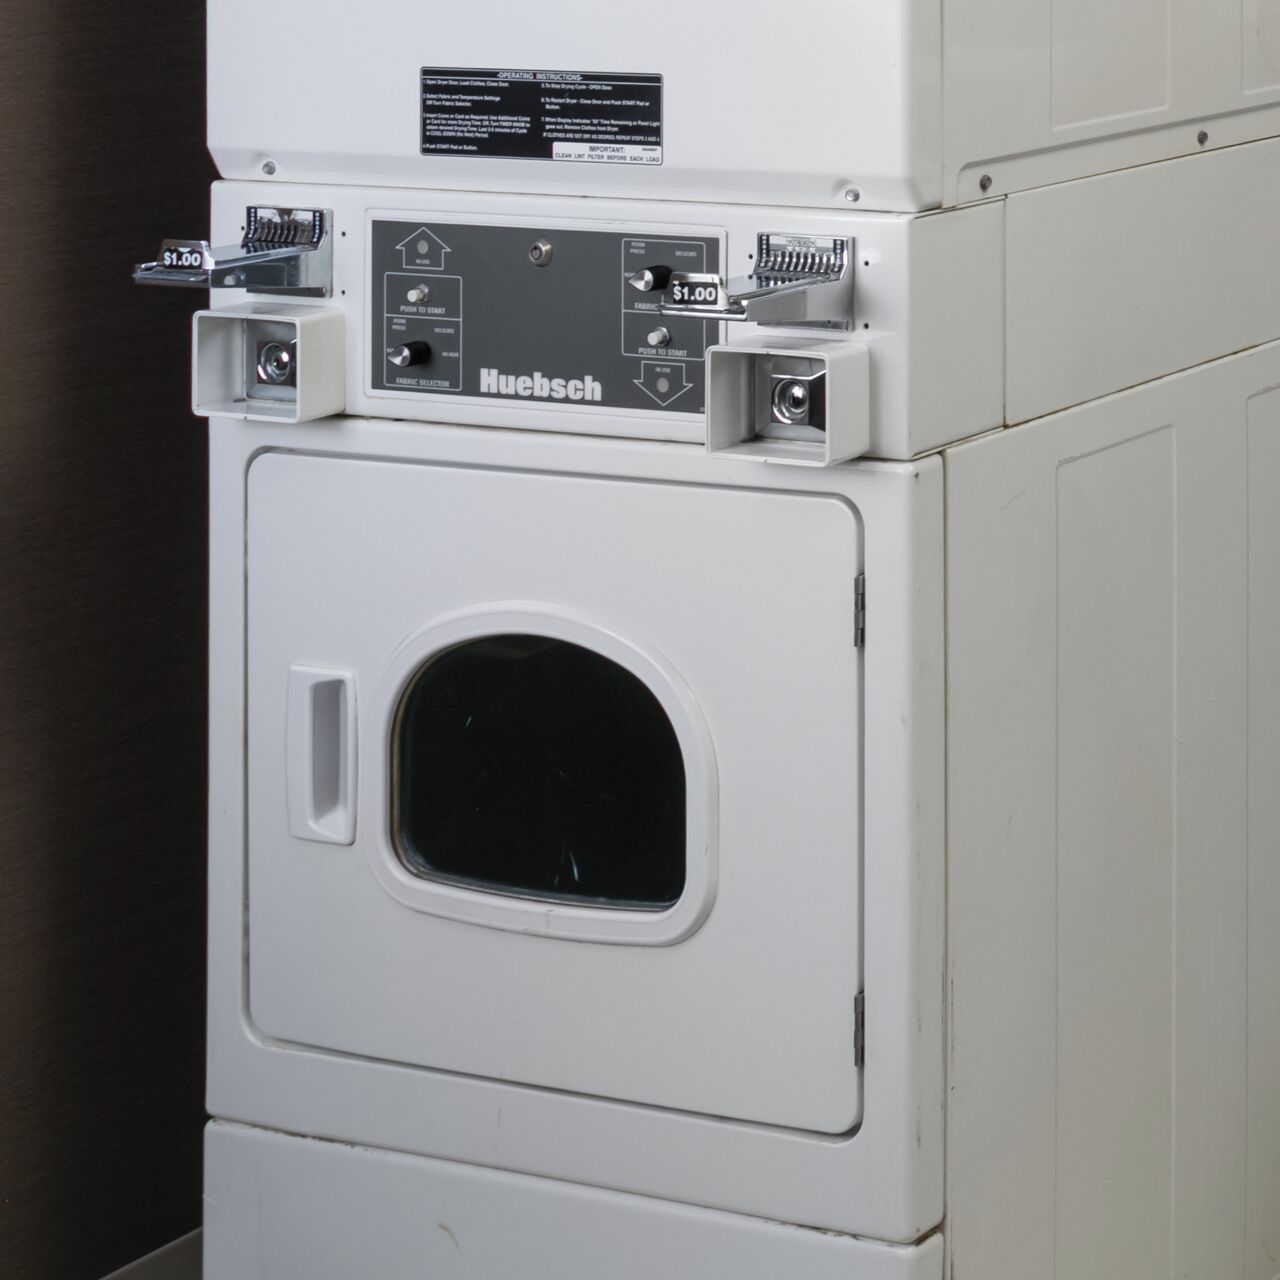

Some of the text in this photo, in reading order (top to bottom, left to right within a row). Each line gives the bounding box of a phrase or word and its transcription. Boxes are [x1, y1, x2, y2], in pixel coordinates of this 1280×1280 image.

[163, 251, 201, 266] $1.00
[672, 285, 716, 301] $1.00
[400, 305, 417, 313] PUSH
[427, 307, 446, 315] START
[634, 302, 658, 310] FABRIC
[638, 347, 688, 357] PUSH TO START
[395, 377, 450, 388] FABRIC SELECTOR
[479, 367, 602, 401] Huebsch
